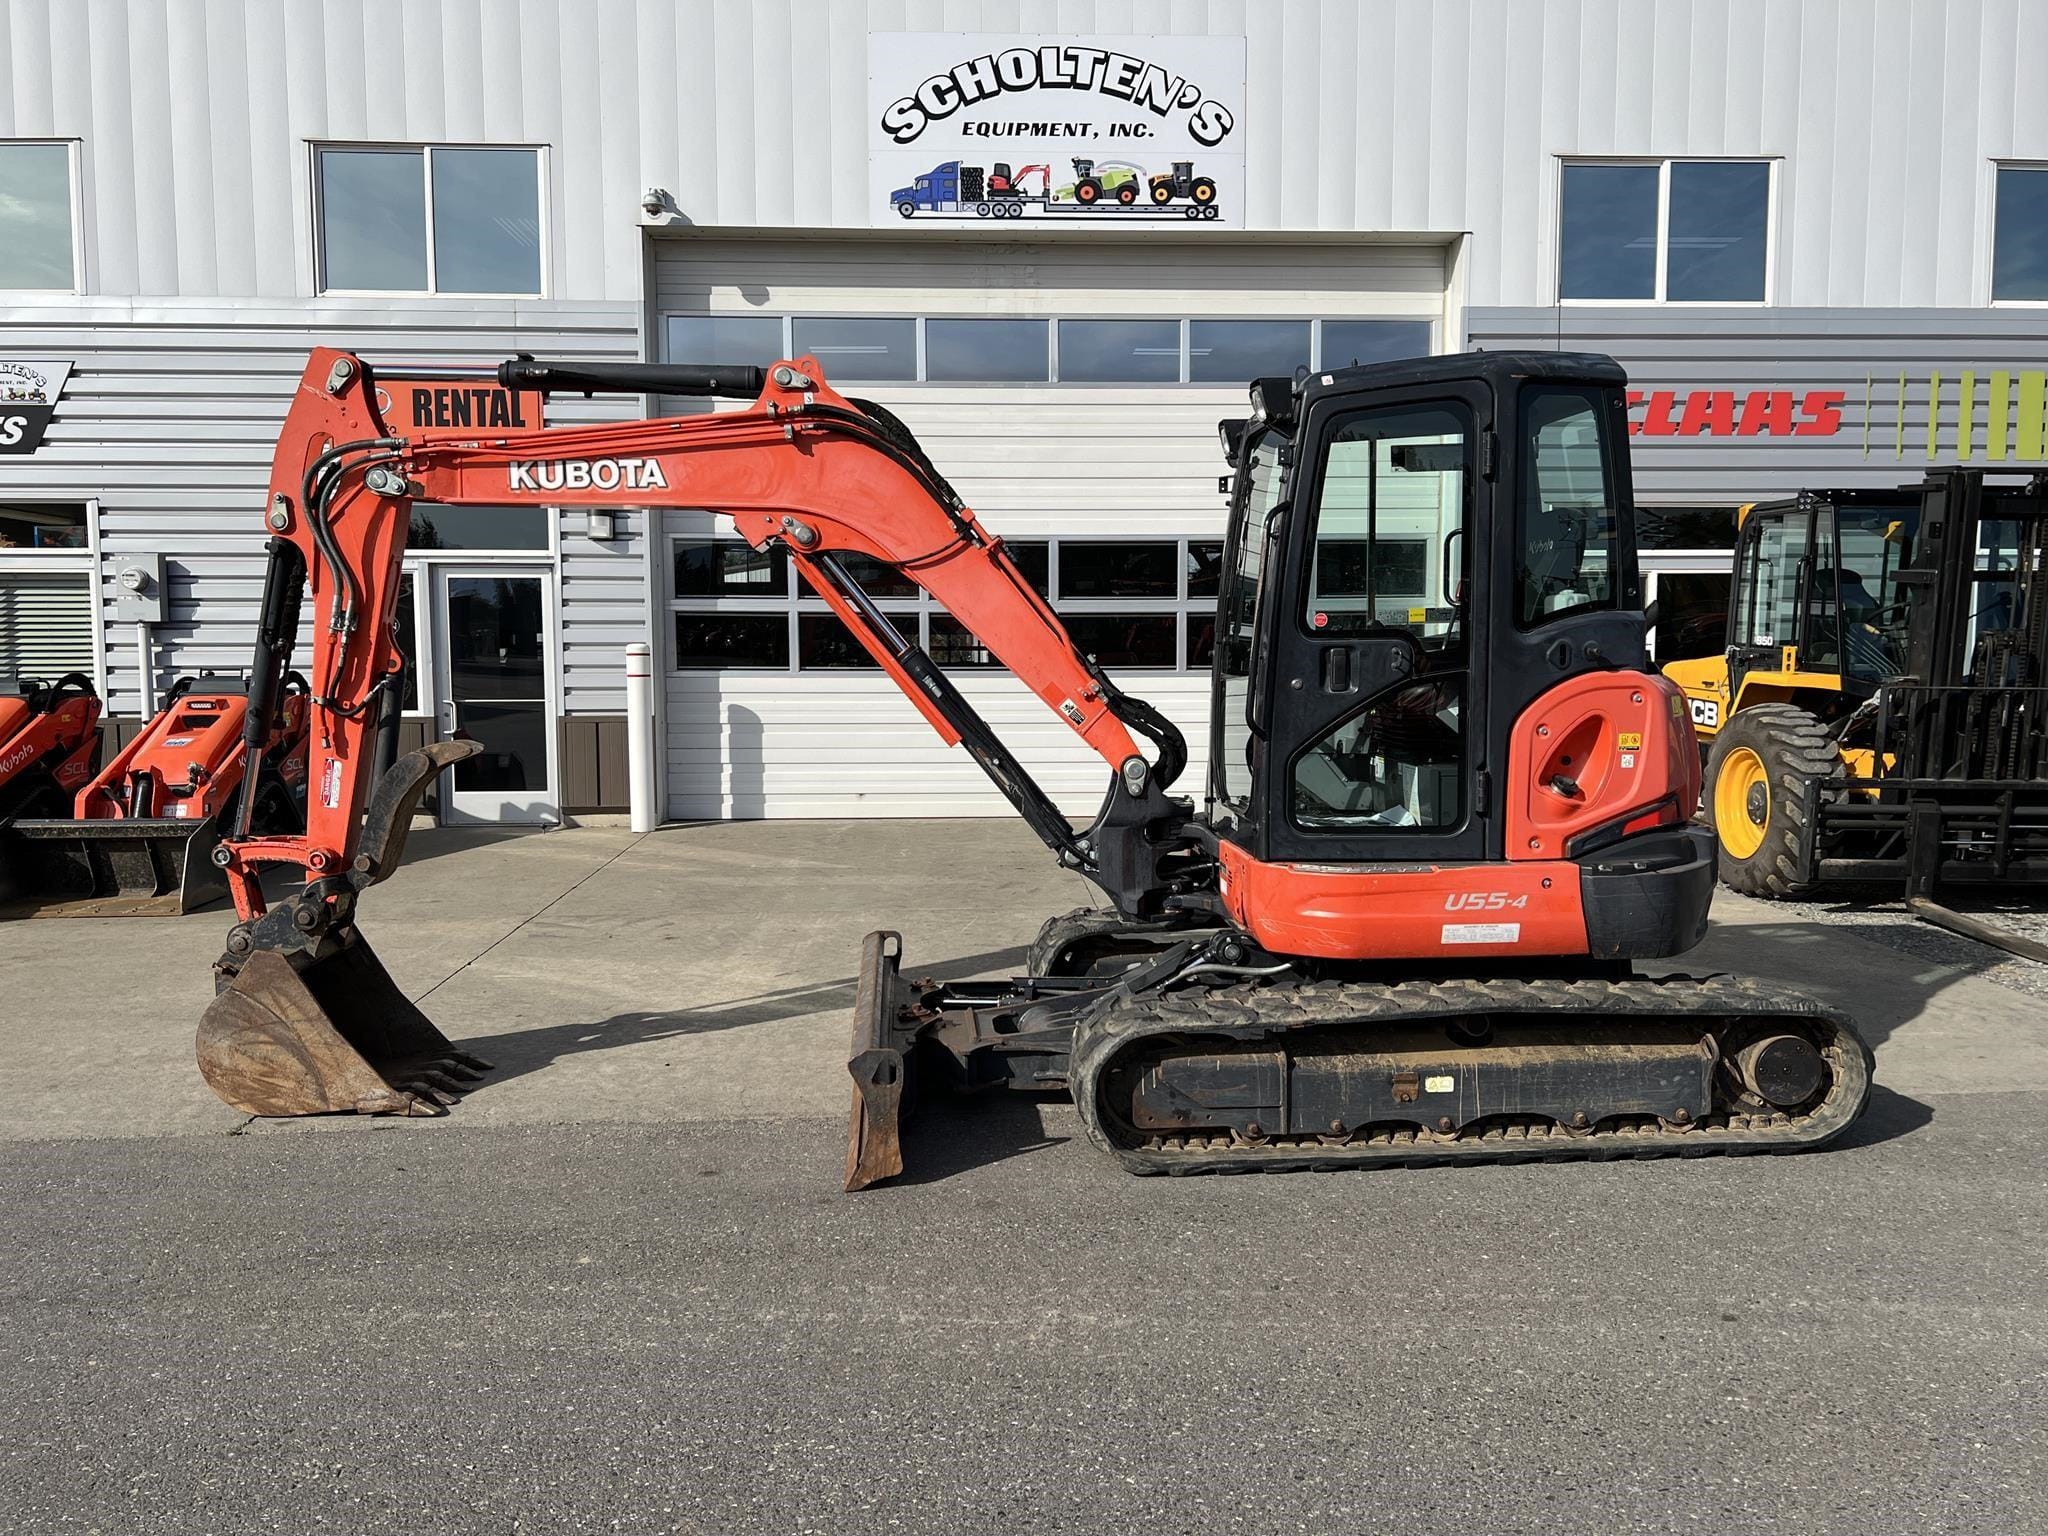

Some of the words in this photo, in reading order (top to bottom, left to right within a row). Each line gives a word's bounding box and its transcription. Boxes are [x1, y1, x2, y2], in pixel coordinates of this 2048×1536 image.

[881, 46, 1234, 147] SCHOLTEN'S
[962, 122, 1100, 140] EQUIPMENT,
[1109, 123, 1155, 138] INC.
[412, 388, 526, 428] RENTAL
[509, 458, 667, 491] KUBOTA
[1688, 698, 1719, 727] CB
[1444, 892, 1529, 911] U55-4
